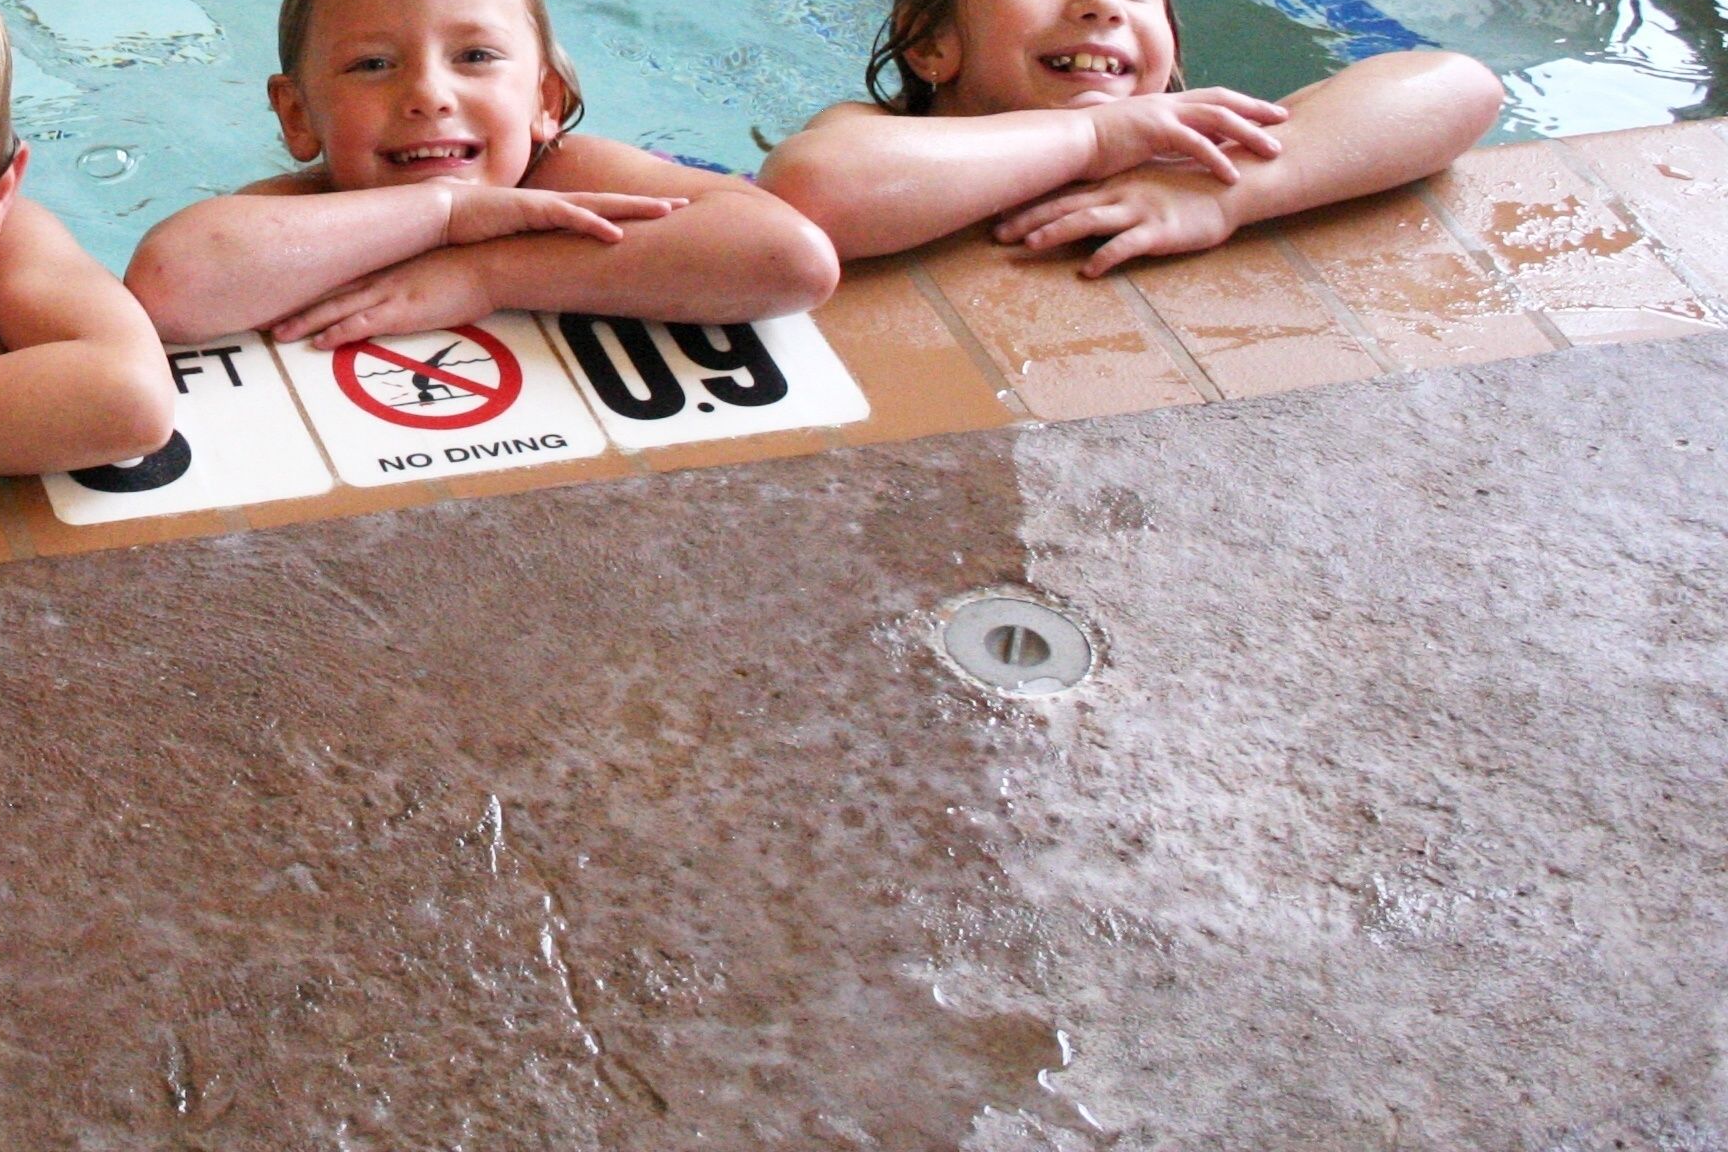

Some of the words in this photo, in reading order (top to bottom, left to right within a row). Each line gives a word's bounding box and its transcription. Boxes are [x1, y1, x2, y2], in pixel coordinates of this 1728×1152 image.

[166, 345, 243, 394] FT
[558, 311, 789, 421] 0.9
[377, 452, 434, 473] NO
[443, 433, 569, 464] DIVING
